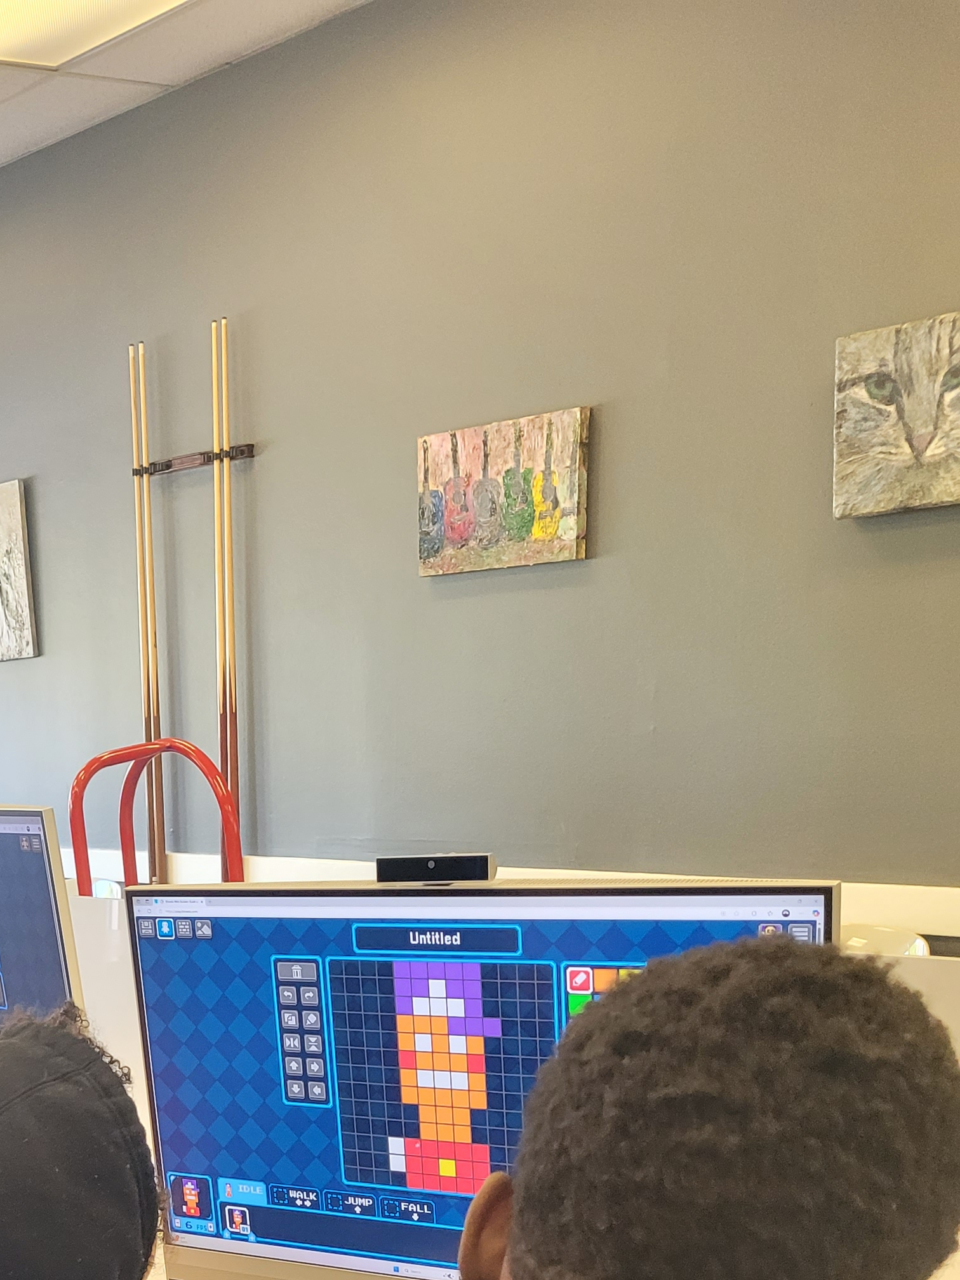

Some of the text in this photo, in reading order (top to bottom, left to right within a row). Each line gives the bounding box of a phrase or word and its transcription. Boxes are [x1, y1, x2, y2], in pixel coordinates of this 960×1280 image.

[409, 931, 461, 946] Untitled
[238, 1184, 263, 1195] IDLE
[289, 1189, 318, 1201] WALK
[344, 1196, 373, 1207] JUMP
[401, 1202, 432, 1214] FALL
[185, 1221, 193, 1230] 6
